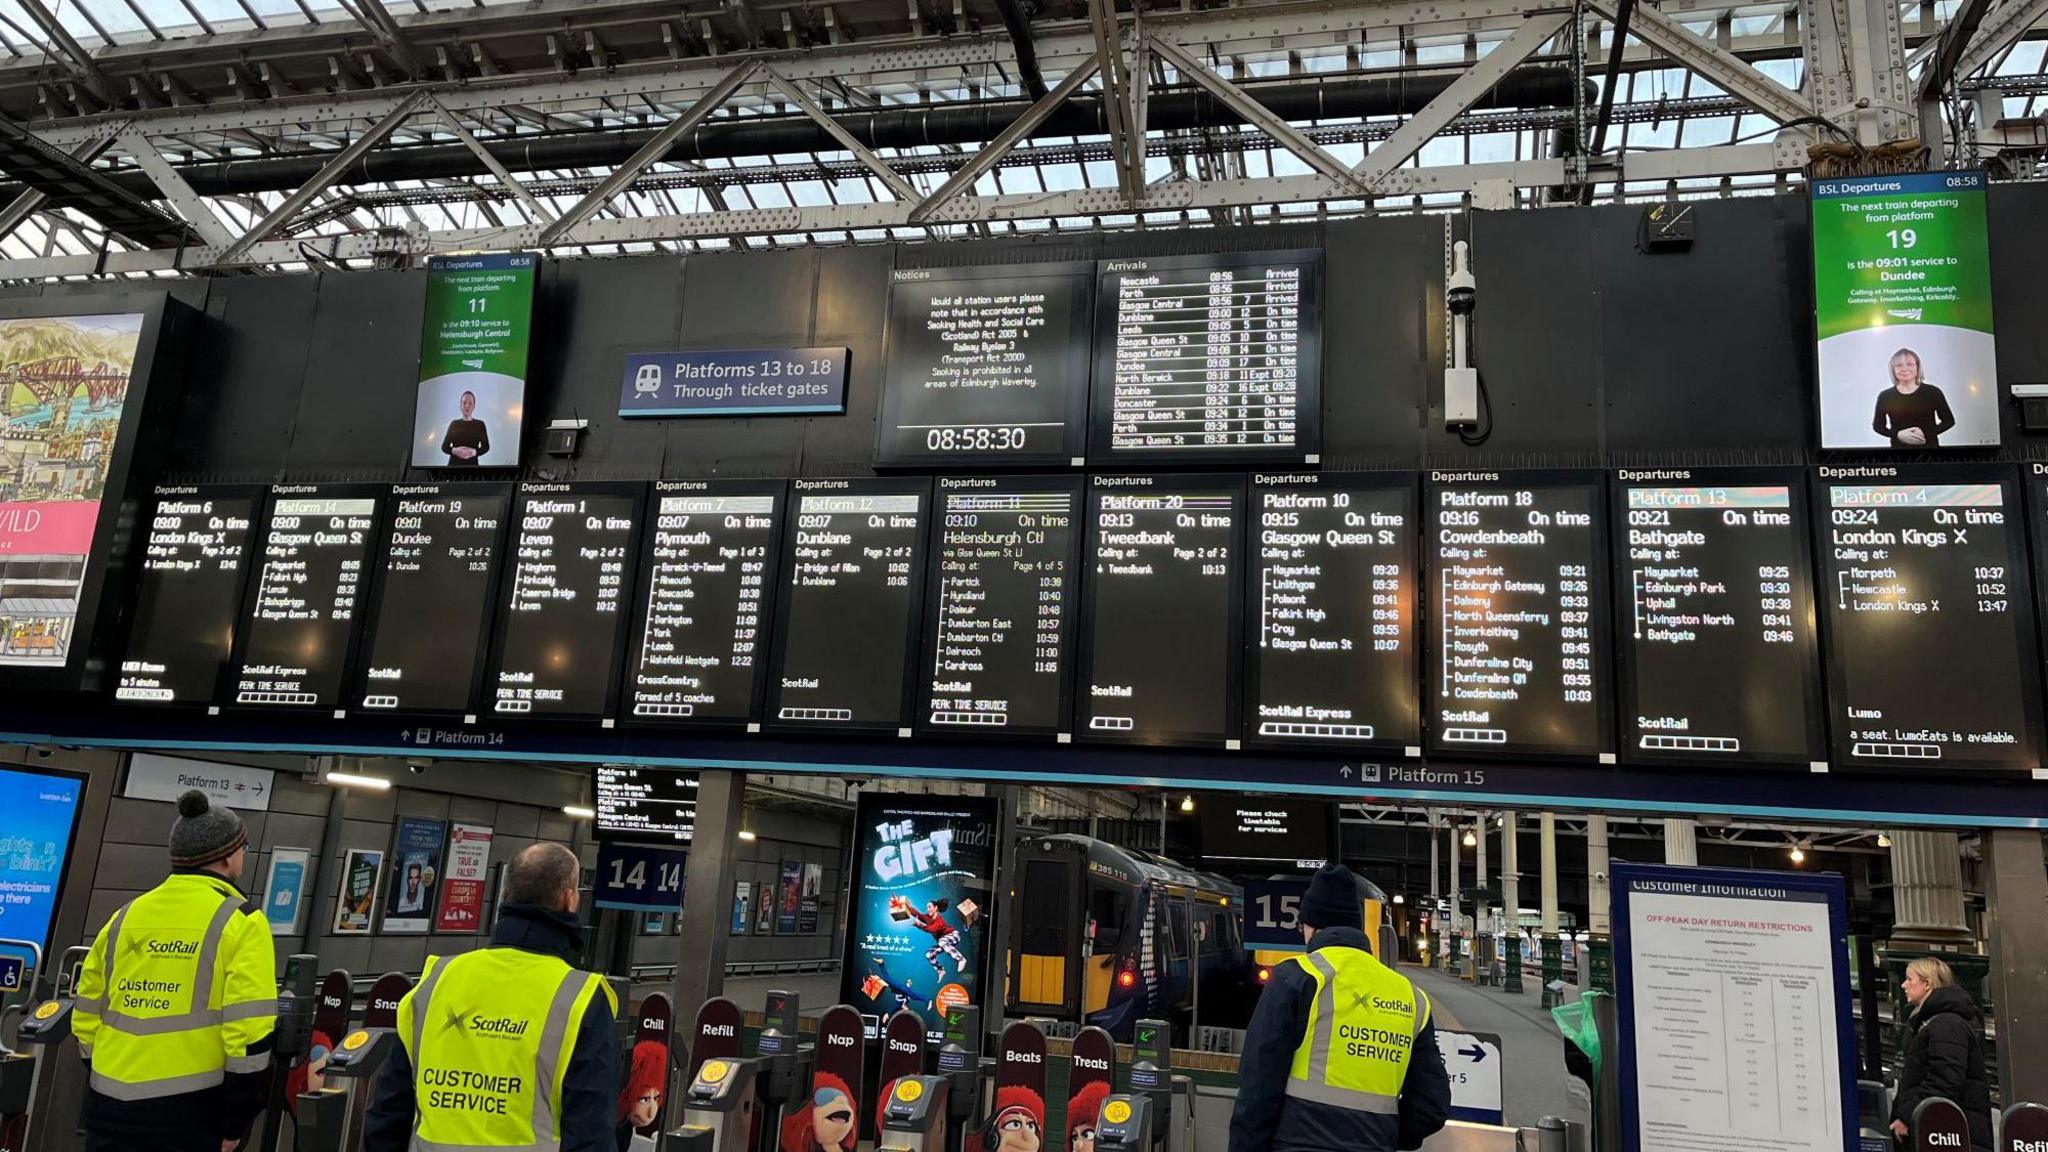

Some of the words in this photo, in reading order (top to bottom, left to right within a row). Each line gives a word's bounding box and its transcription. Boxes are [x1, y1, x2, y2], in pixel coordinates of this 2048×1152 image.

[1819, 185, 1838, 194] BSL
[1842, 182, 1901, 193] Departures
[1947, 177, 1978, 187] 08:58
[1840, 203, 1860, 211] The
[1862, 202, 1883, 211] next
[1885, 201, 1908, 210] train
[1911, 198, 1958, 209] departing
[1866, 214, 1889, 222] from
[1891, 211, 1933, 222] platform
[1886, 229, 1916, 249] 19
[1107, 261, 1147, 271] Arrivals
[1848, 260, 1855, 269] is
[1857, 260, 1873, 268] the
[1876, 258, 1907, 267] 09:01
[1910, 257, 1944, 266] service
[1946, 257, 1957, 265] to
[895, 271, 929, 280] Notices
[1881, 271, 1925, 281] Dundee
[1020, 294, 1044, 303] please
[468, 299, 486, 313] 11
[460, 320, 480, 328] 09:10
[440, 330, 483, 339] Helensburgh
[675, 363, 755, 379] Platforms
[761, 361, 781, 377] 13
[786, 362, 804, 376] to
[809, 360, 832, 375] 18
[674, 384, 732, 400] Through
[741, 382, 783, 396] ticket
[787, 382, 828, 397] gates
[1114, 399, 1157, 408] Doncaster
[1264, 395, 1275, 404] On
[1278, 395, 1295, 404] time
[927, 428, 1025, 450] 08:58:30
[1619, 470, 1690, 481] Departures
[1819, 466, 1897, 477] Departures
[941, 478, 996, 488] Departures
[1255, 474, 1318, 484] Departures
[393, 485, 439, 495] Departures
[656, 482, 707, 491] Departures
[1264, 494, 1326, 508] Platform
[1333, 494, 1349, 508] 10
[1441, 492, 1508, 507] Platform
[1515, 492, 1532, 506] 18
[1629, 492, 1700, 506] Platform
[1708, 491, 1727, 505] 13
[1832, 489, 1908, 504] Platform
[1915, 489, 1927, 503] 4
[158, 502, 201, 514] Platform
[203, 502, 212, 513] 6
[399, 501, 444, 513] Platform
[448, 502, 461, 513] 19
[799, 516, 831, 527] 09:07
[945, 515, 977, 527] 09:10
[1262, 513, 1298, 526] 09:15
[1440, 512, 1479, 525] 09:16
[1629, 511, 1670, 525] 09:21
[1723, 511, 1746, 525] On
[1753, 511, 1790, 524] time
[1831, 510, 1878, 524] 09:24
[1933, 509, 1958, 524] On
[1965, 509, 2004, 524] time
[392, 532, 431, 544] Dundee
[520, 533, 553, 545] Leven
[655, 533, 710, 546] Plymouth
[797, 532, 851, 544] Dunblane
[944, 532, 1020, 547] Helensburgh
[1099, 531, 1175, 544] Tweedbank
[1262, 532, 1320, 546] Glasgow
[1326, 532, 1373, 546] Queen
[1378, 532, 1395, 544] St
[1440, 530, 1545, 544] Cowdenbeath
[1629, 531, 1705, 547] Bathgate
[1833, 530, 1895, 545] London
[1902, 530, 1946, 547] Kings
[1953, 530, 1967, 544] X
[948, 619, 989, 629] Dumbarton
[993, 619, 1011, 629] East
[1454, 611, 1483, 622] North
[1561, 612, 1588, 623] 09:37
[1648, 614, 1699, 626] Livingston
[1703, 615, 1734, 625] North
[1763, 615, 1791, 626] 09:41
[1259, 706, 1302, 717] ScotRail
[1306, 707, 1351, 720] Express
[1848, 707, 1882, 719] Lumo
[435, 731, 485, 744] Platform
[488, 732, 504, 745] 14
[1862, 730, 1892, 740] seat.
[1895, 730, 1948, 742] LumoEats
[1967, 732, 2018, 743] available.
[178, 773, 219, 790] Platform
[220, 778, 229, 790] 13
[1389, 767, 1458, 784] Platform
[1463, 770, 1484, 785] 15
[875, 820, 914, 842] THE
[874, 829, 952, 882] GIFT
[608, 859, 646, 890] 14
[658, 863, 680, 892] 14
[6, 894, 31, 904] there
[1255, 894, 1300, 929] 15
[1646, 915, 1690, 925] OFF-PEAK
[1691, 918, 1709, 926] DAY
[1710, 919, 1746, 928] RETURN
[1749, 921, 1813, 932] RESTRICTIONS
[147, 940, 198, 954] ScotRail
[118, 978, 181, 992] Customer
[124, 994, 169, 1009] Service
[324, 995, 341, 1009] Nap
[374, 998, 400, 1010] Sna
[1373, 997, 1413, 1013] ScotRail
[470, 1016, 528, 1034] ScotRail
[643, 1017, 664, 1031] Chill
[702, 1023, 734, 1038] Refill
[828, 1033, 854, 1050] Nap
[1339, 1025, 1411, 1049] CUSTOMER
[890, 1039, 917, 1054] Snap
[1346, 1043, 1402, 1063] SERVICE
[1006, 1049, 1041, 1064] Beats
[1074, 1056, 1108, 1071] Treats
[424, 1068, 521, 1094] CUSTOMER
[1460, 1073, 1467, 1083] 5
[429, 1090, 507, 1114] SERVICE
[1929, 1132, 1961, 1146] Chill
